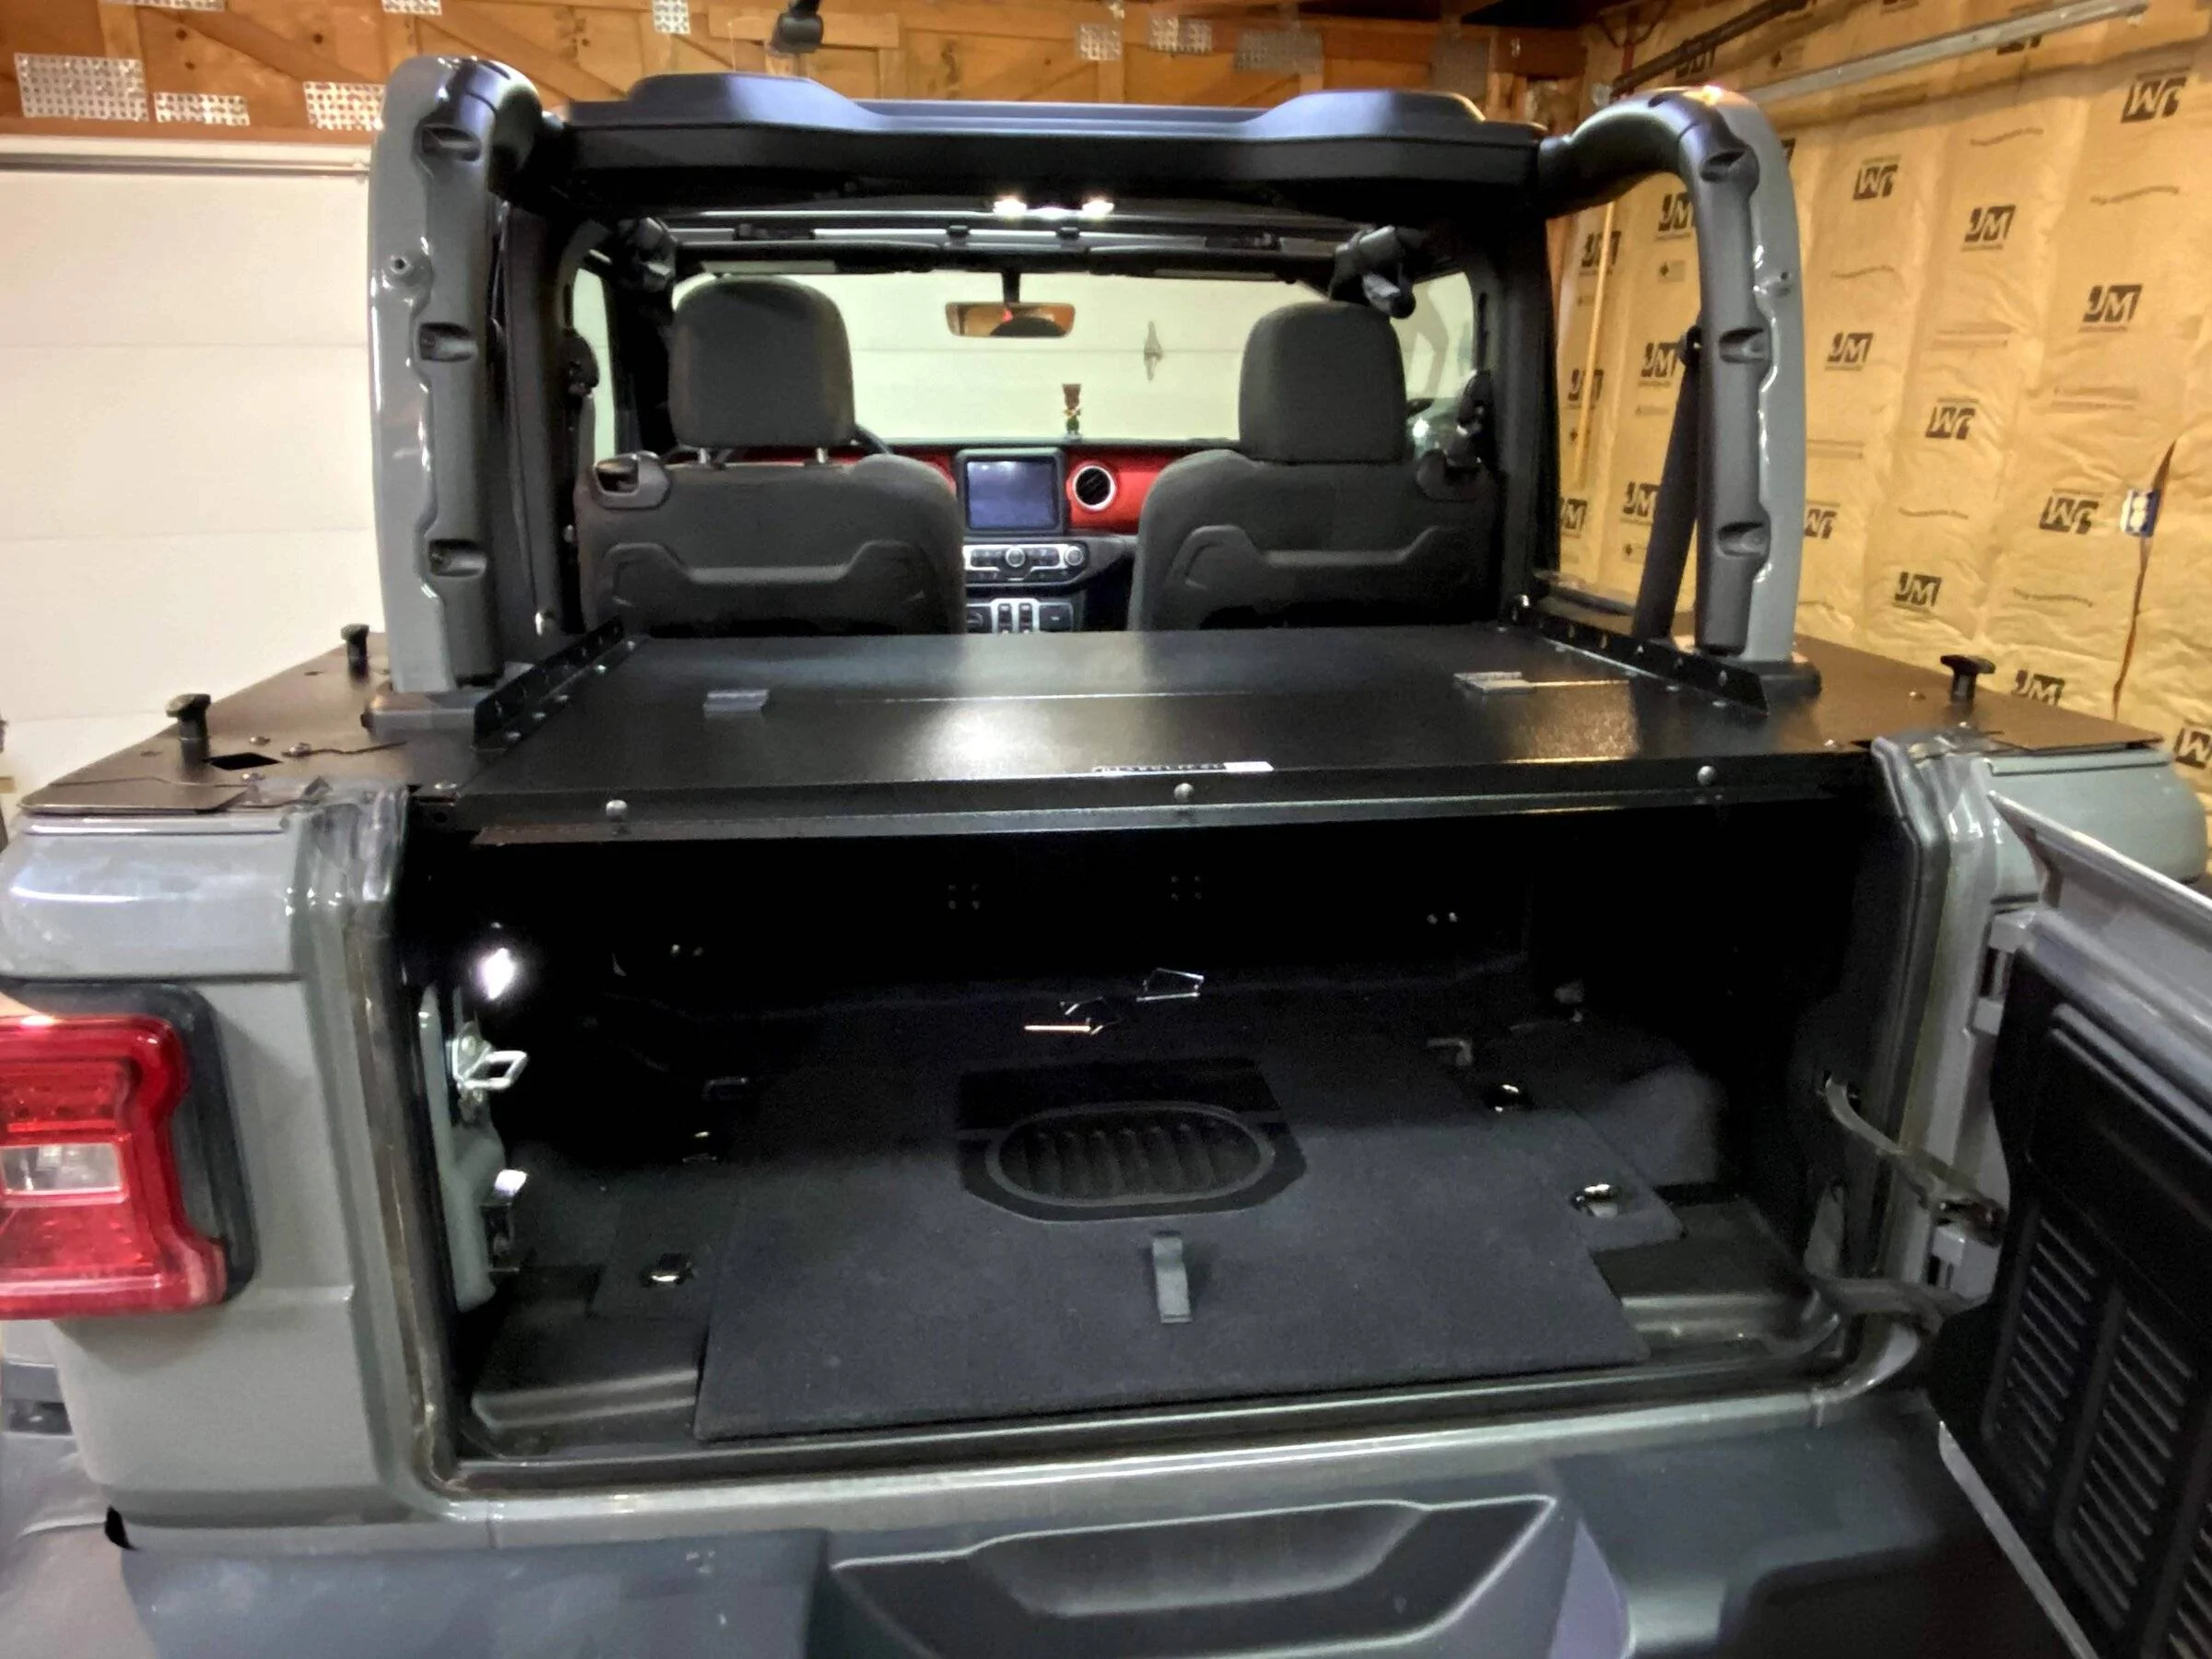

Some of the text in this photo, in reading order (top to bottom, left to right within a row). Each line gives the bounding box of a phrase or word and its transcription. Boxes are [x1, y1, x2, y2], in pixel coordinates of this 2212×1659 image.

[1964, 205, 2017, 242] JM
[2082, 285, 2143, 323] JM
[1827, 332, 1874, 362] JM
[1895, 571, 1942, 606] JM
